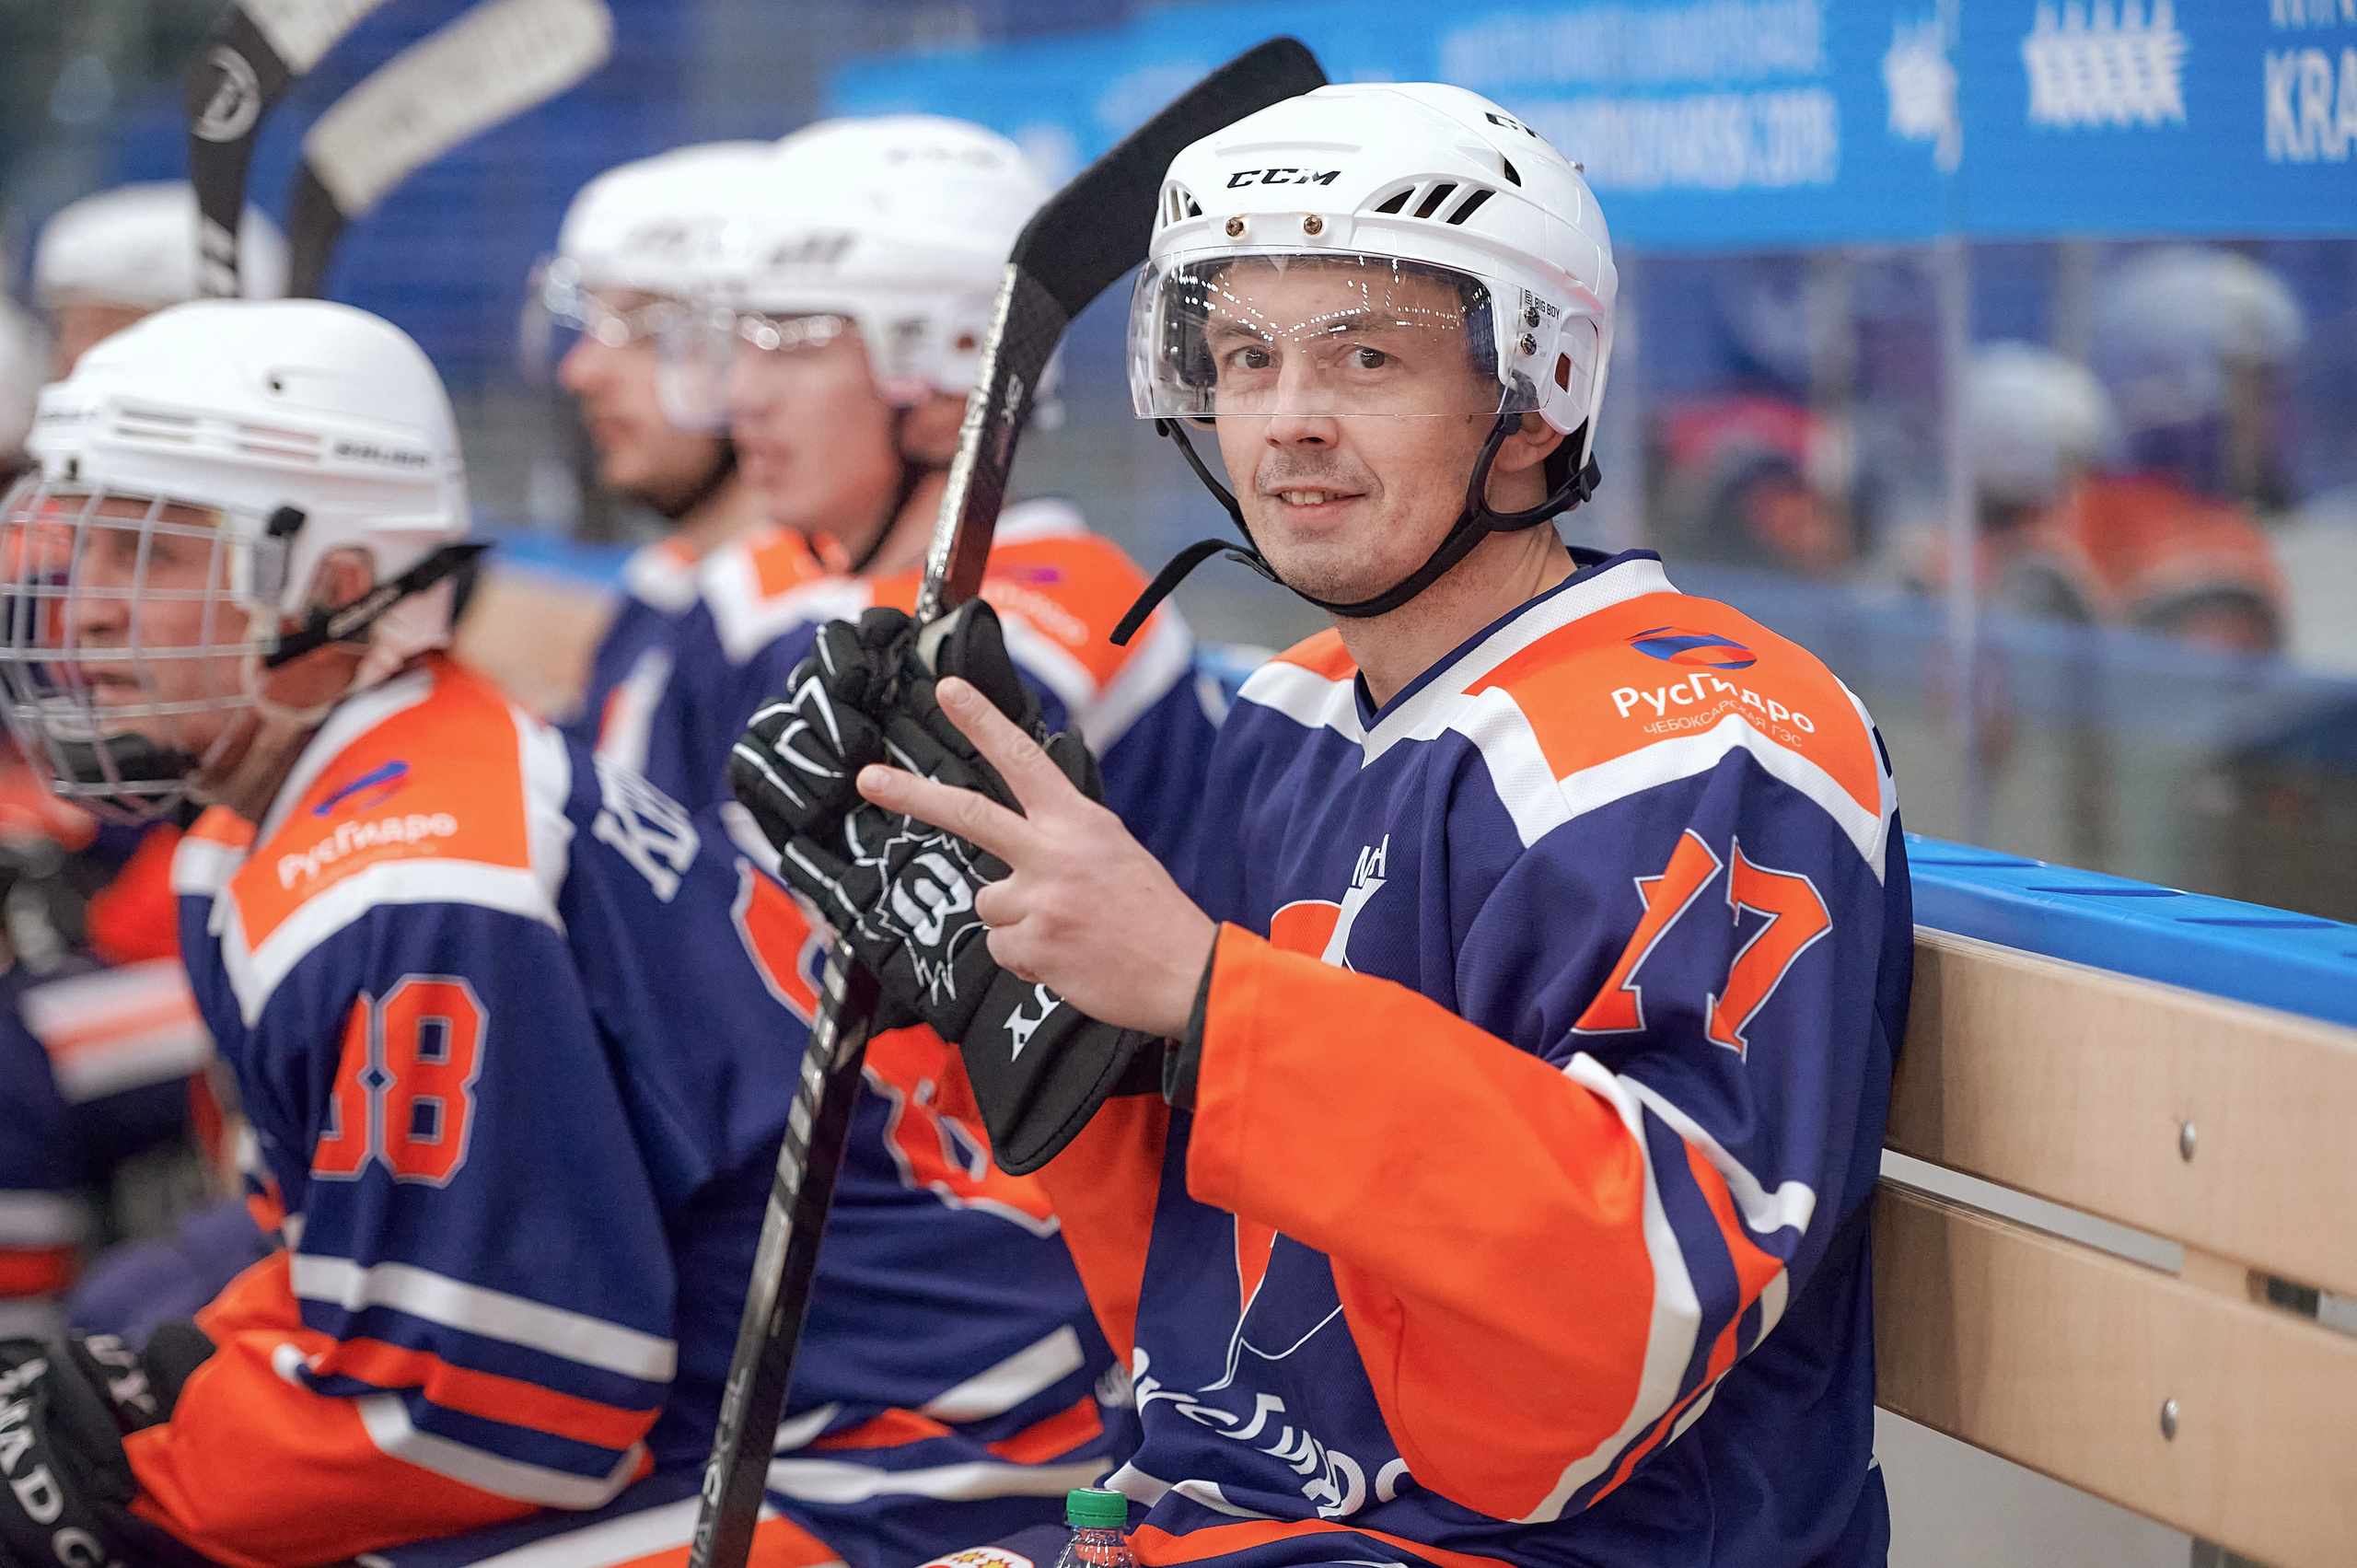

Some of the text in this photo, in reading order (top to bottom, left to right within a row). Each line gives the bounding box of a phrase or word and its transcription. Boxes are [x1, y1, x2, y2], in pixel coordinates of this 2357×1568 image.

[1226, 168, 1341, 189] CCM
[1534, 296, 1561, 320] BIG BOY
[1611, 672, 1816, 734] РусГидро
[1771, 723, 1803, 748] ГЭС
[1569, 827, 1833, 1064] 17
